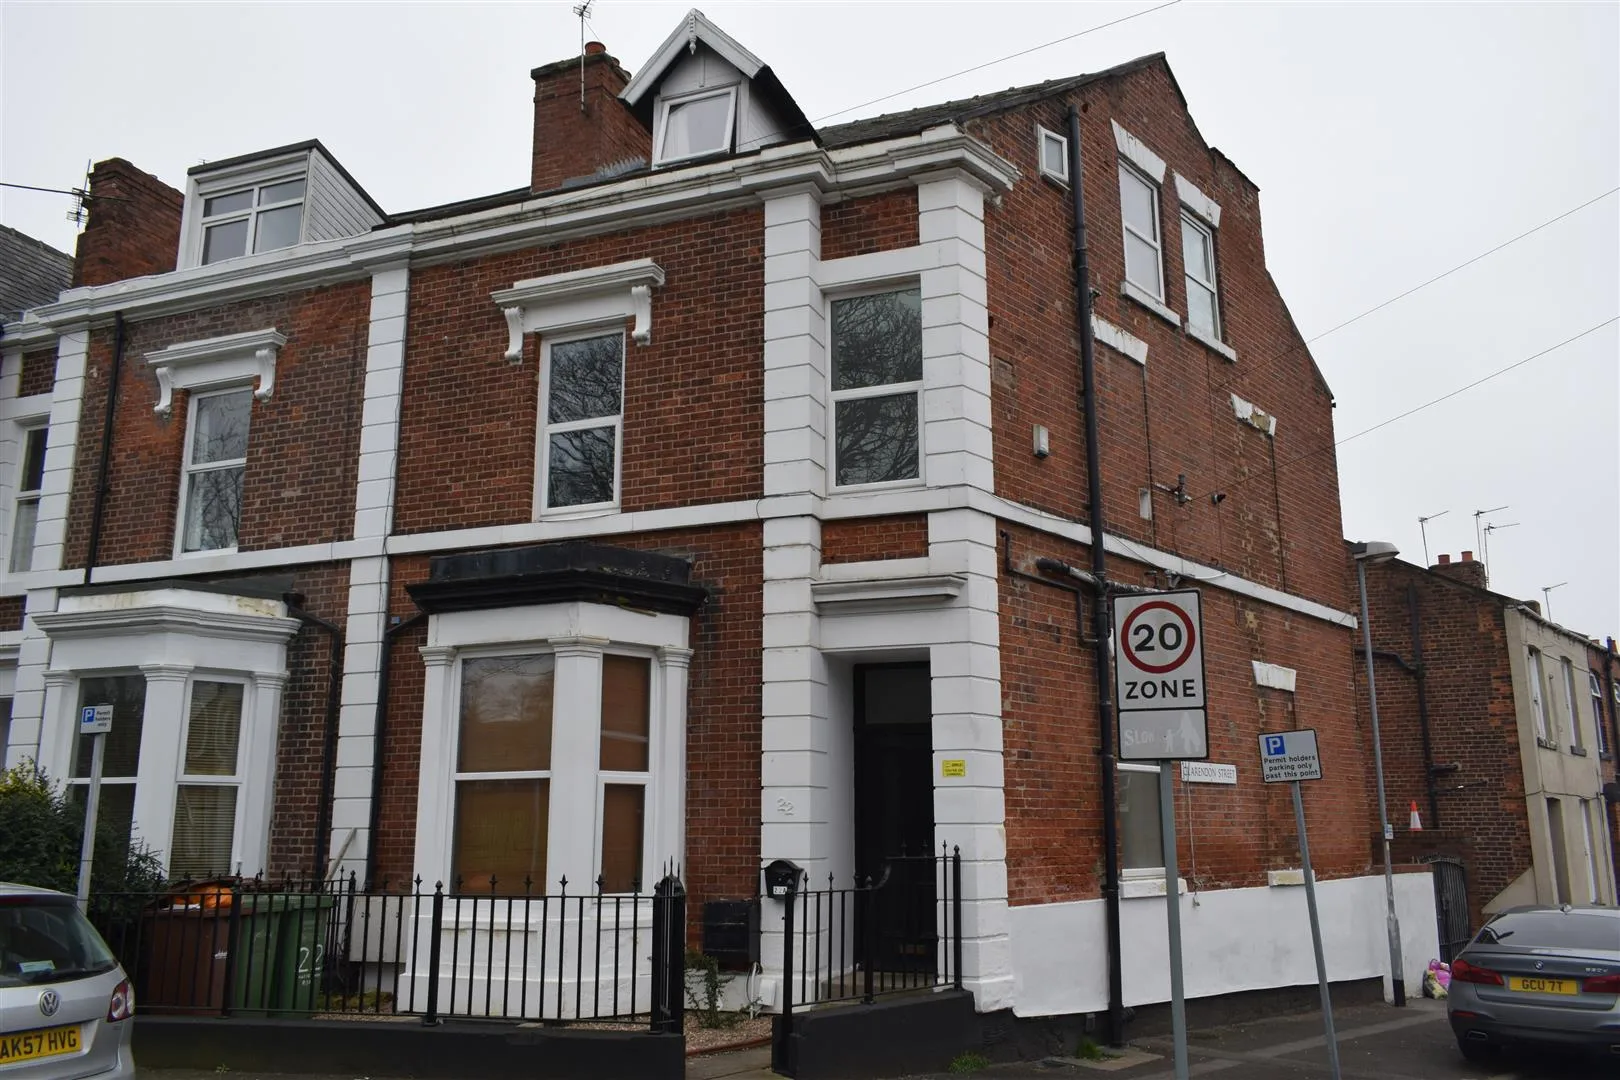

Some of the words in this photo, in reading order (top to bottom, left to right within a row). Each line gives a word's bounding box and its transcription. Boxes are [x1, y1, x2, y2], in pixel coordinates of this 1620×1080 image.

[1133, 623, 1182, 651] 20
[1125, 679, 1196, 700] ZONE
[1269, 737, 1281, 754] P
[1264, 756, 1287, 765] Permit
[1288, 755, 1316, 763] holders
[1269, 764, 1295, 772] parking
[1297, 762, 1313, 770] only
[1218, 768, 1235, 779] STREET
[1265, 772, 1282, 780] past
[1284, 770, 1298, 778] this
[1299, 769, 1319, 777] point
[777, 796, 795, 816] 22
[299, 944, 323, 973] 22
[1522, 979, 1545, 991] GCU
[1548, 981, 1563, 993] 7T
[0, 1034, 43, 1058] AK57
[48, 1030, 76, 1052] HVG
